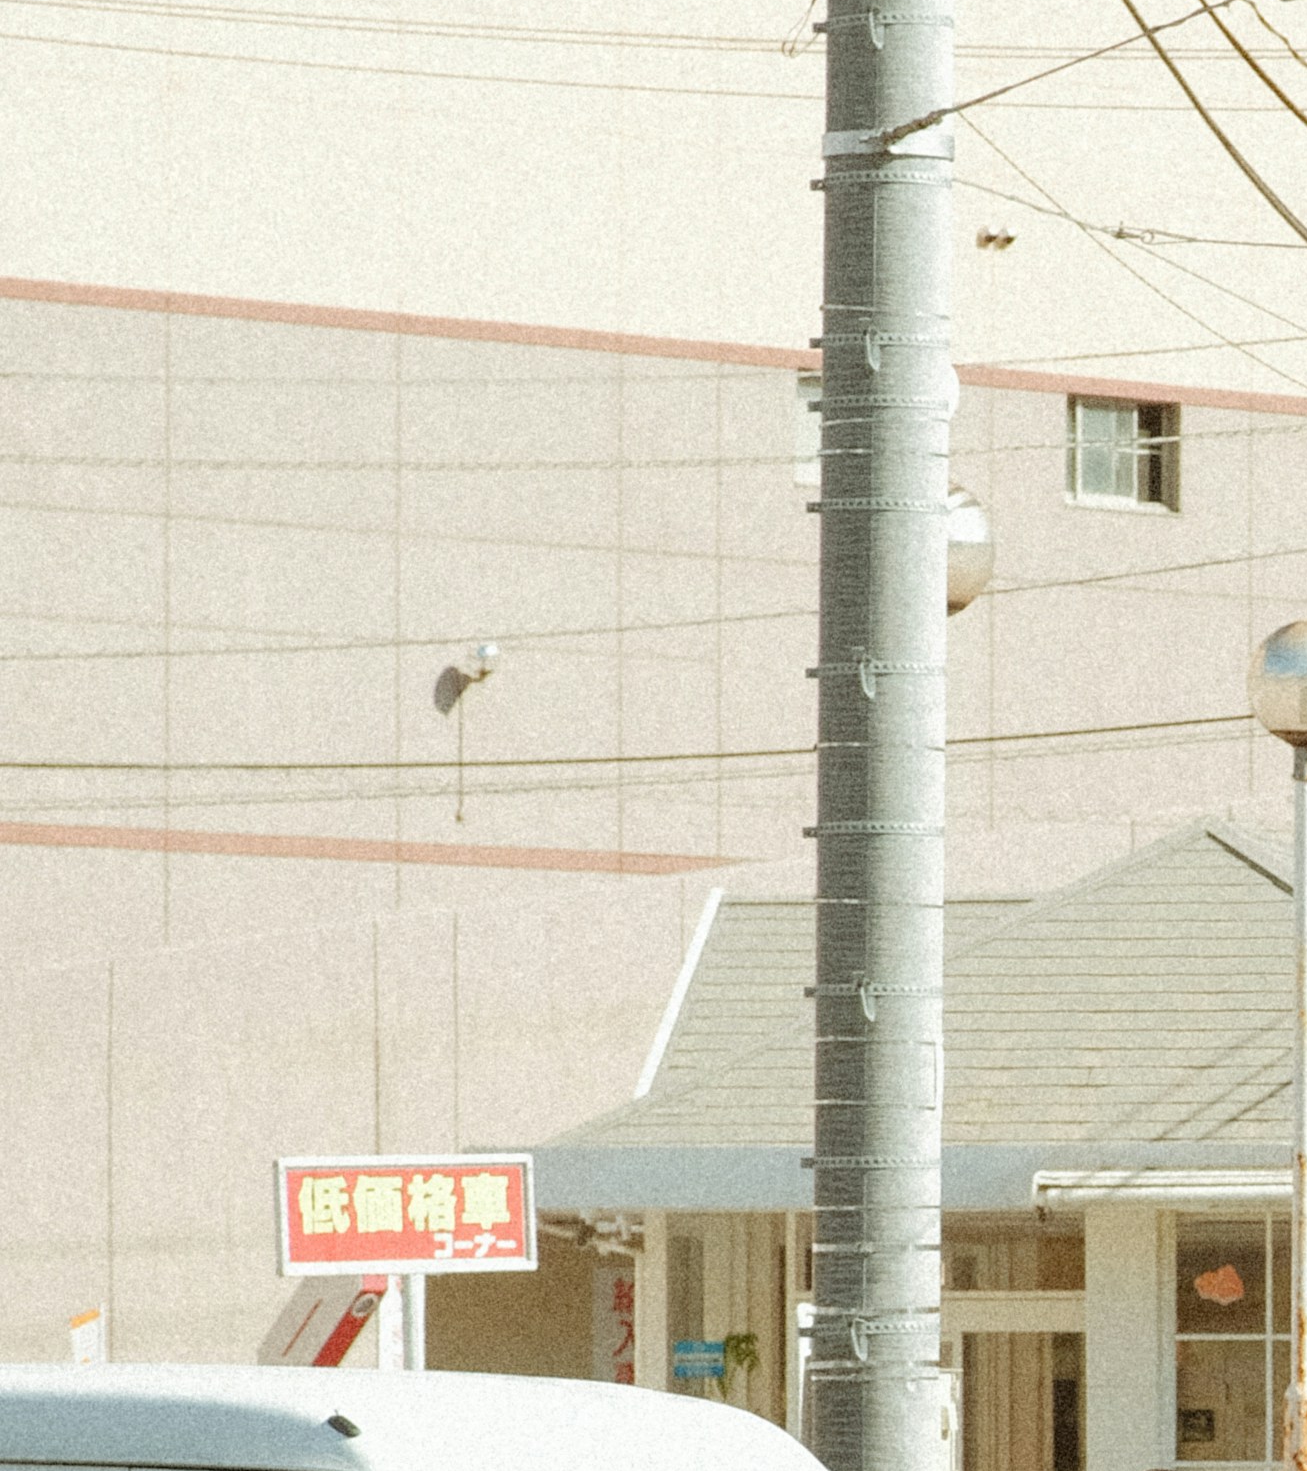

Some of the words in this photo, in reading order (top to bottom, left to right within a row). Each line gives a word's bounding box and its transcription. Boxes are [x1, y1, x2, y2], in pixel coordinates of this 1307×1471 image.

[298, 1172, 510, 1235] 低価格車
[434, 1232, 516, 1258] コーナー
